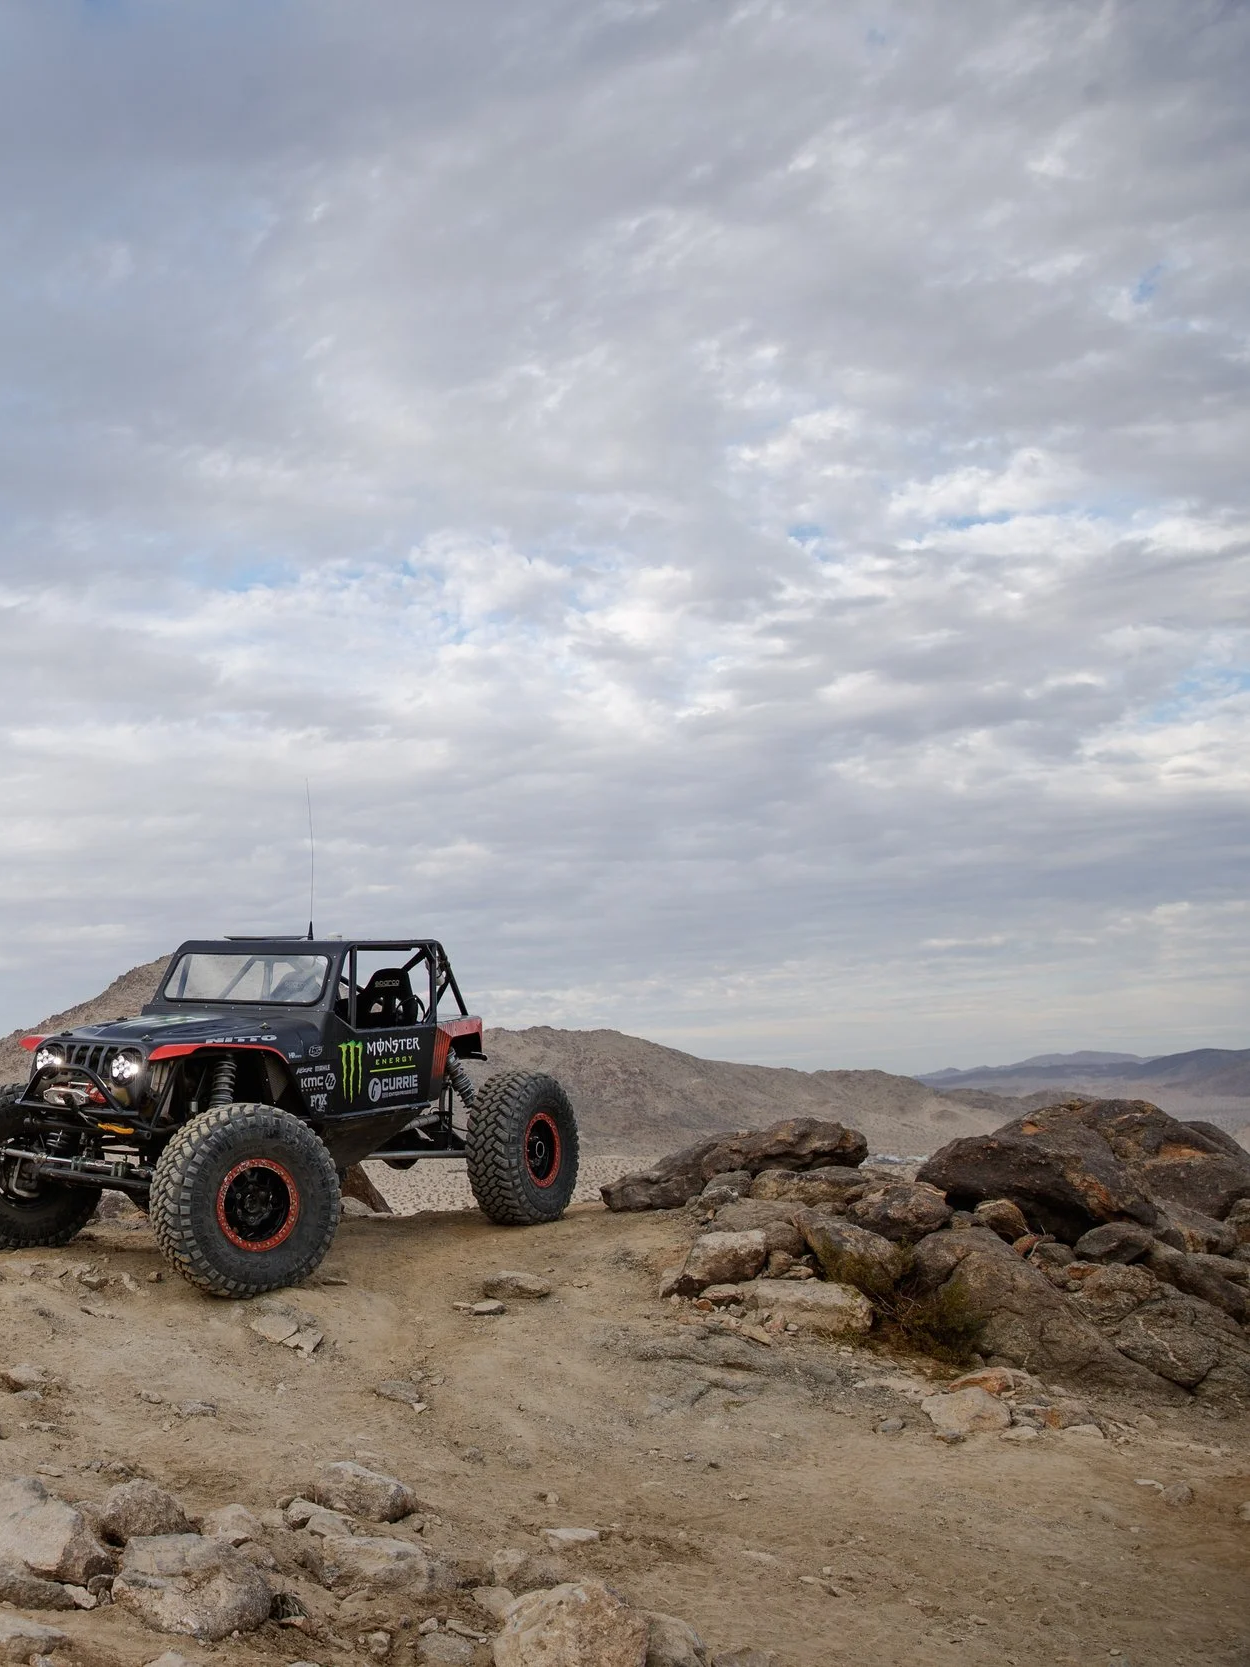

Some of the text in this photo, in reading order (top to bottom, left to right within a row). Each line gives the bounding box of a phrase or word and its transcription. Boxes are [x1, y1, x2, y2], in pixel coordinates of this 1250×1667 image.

[205, 1034, 278, 1044] NITTO
[366, 1036, 421, 1056] MONSTER
[375, 1056, 413, 1066] ENERGY
[300, 1075, 324, 1089] KMC
[381, 1074, 419, 1092] CURRIE
[310, 1093, 328, 1110] FOX
